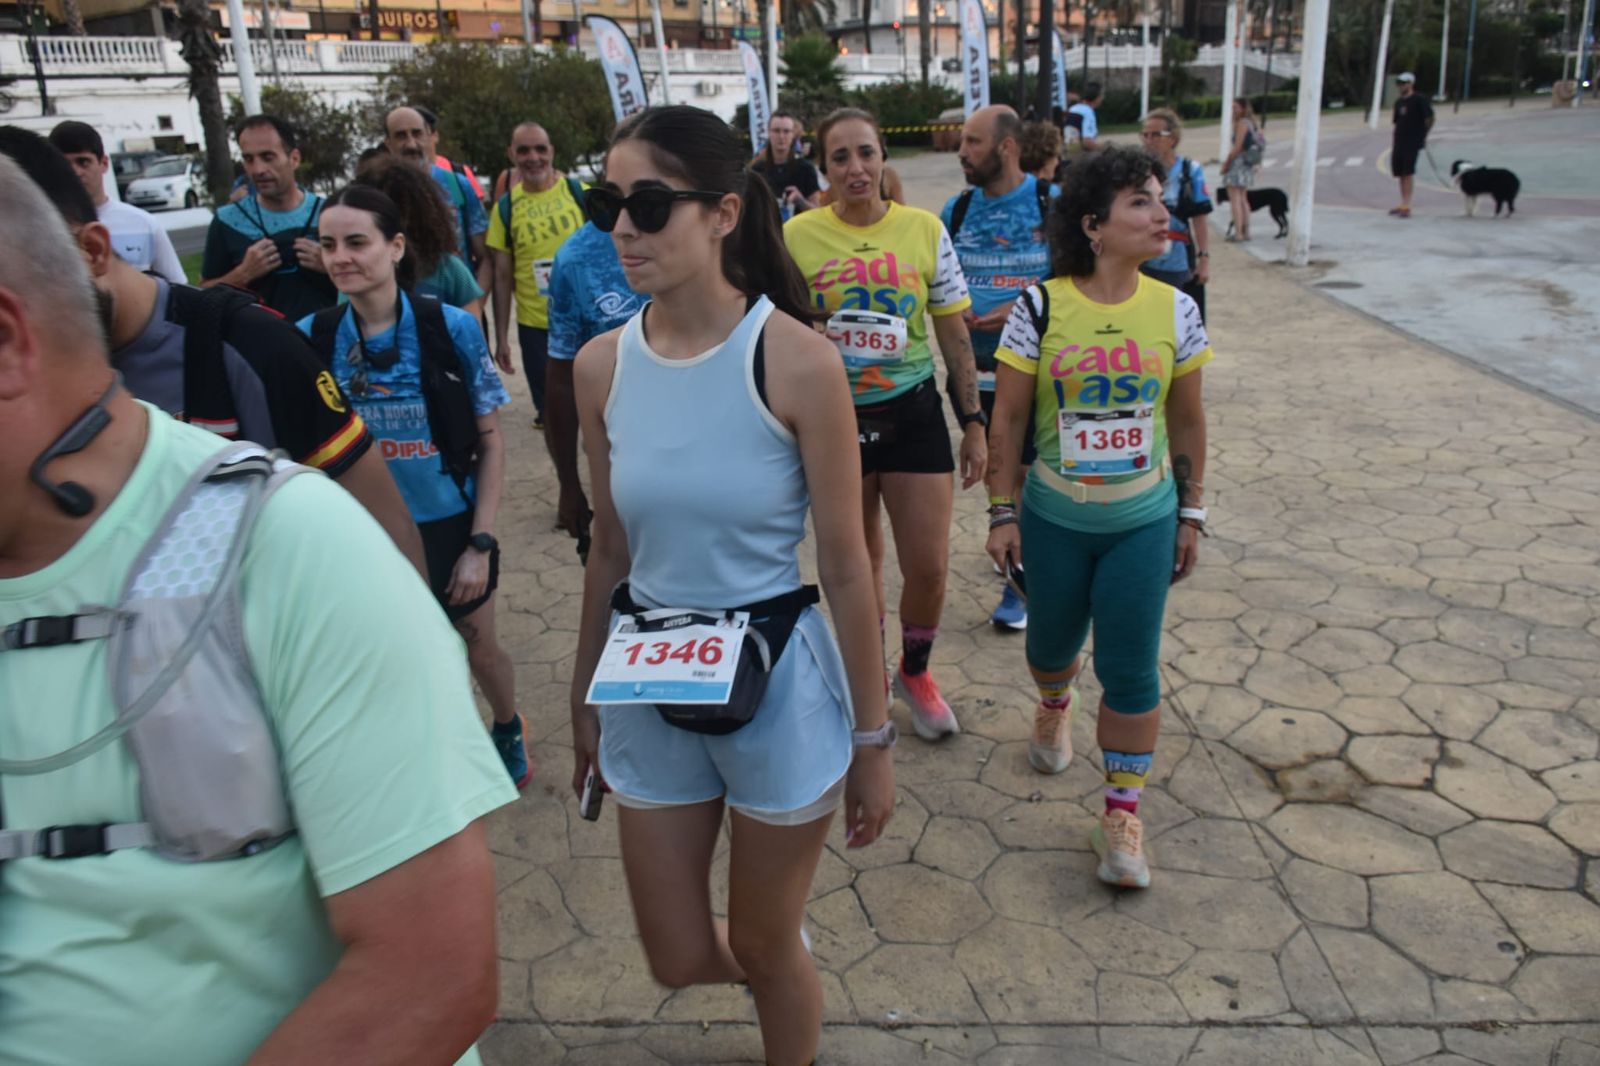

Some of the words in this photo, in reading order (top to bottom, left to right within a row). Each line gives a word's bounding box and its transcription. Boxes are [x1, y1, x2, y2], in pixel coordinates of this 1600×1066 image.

[812, 251, 920, 293] cada
[842, 330, 898, 351] 1363
[1050, 338, 1164, 379] cada
[358, 406, 383, 421] ERA
[384, 404, 426, 420] NOCTU
[1075, 427, 1143, 450] 1368
[624, 635, 724, 666] 1346
